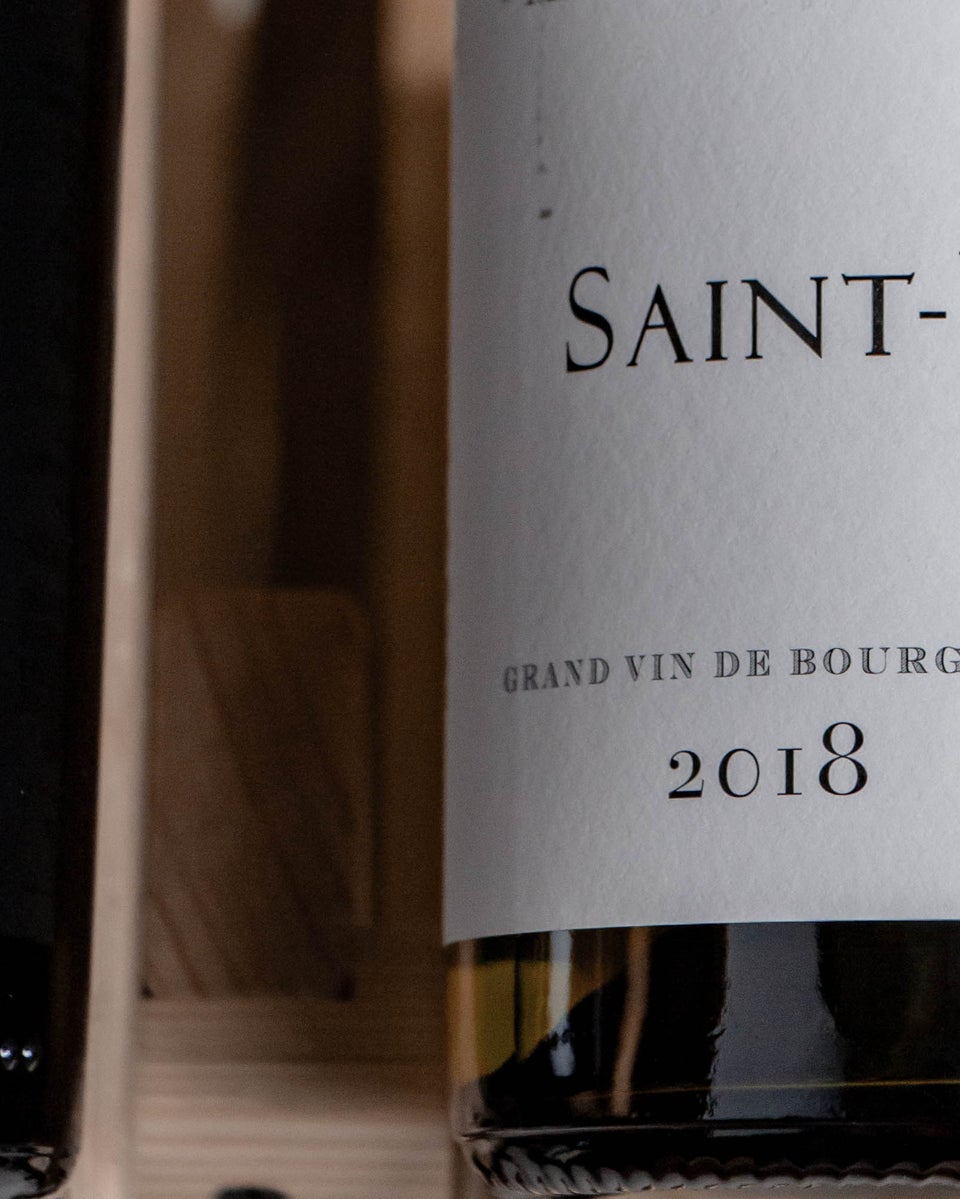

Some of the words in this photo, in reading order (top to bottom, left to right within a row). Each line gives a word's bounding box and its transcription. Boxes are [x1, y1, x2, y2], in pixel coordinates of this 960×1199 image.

[503, 656, 610, 693] GRAND
[624, 651, 696, 681] VIN
[714, 649, 770, 678] DE
[668, 721, 868, 799] 2018
